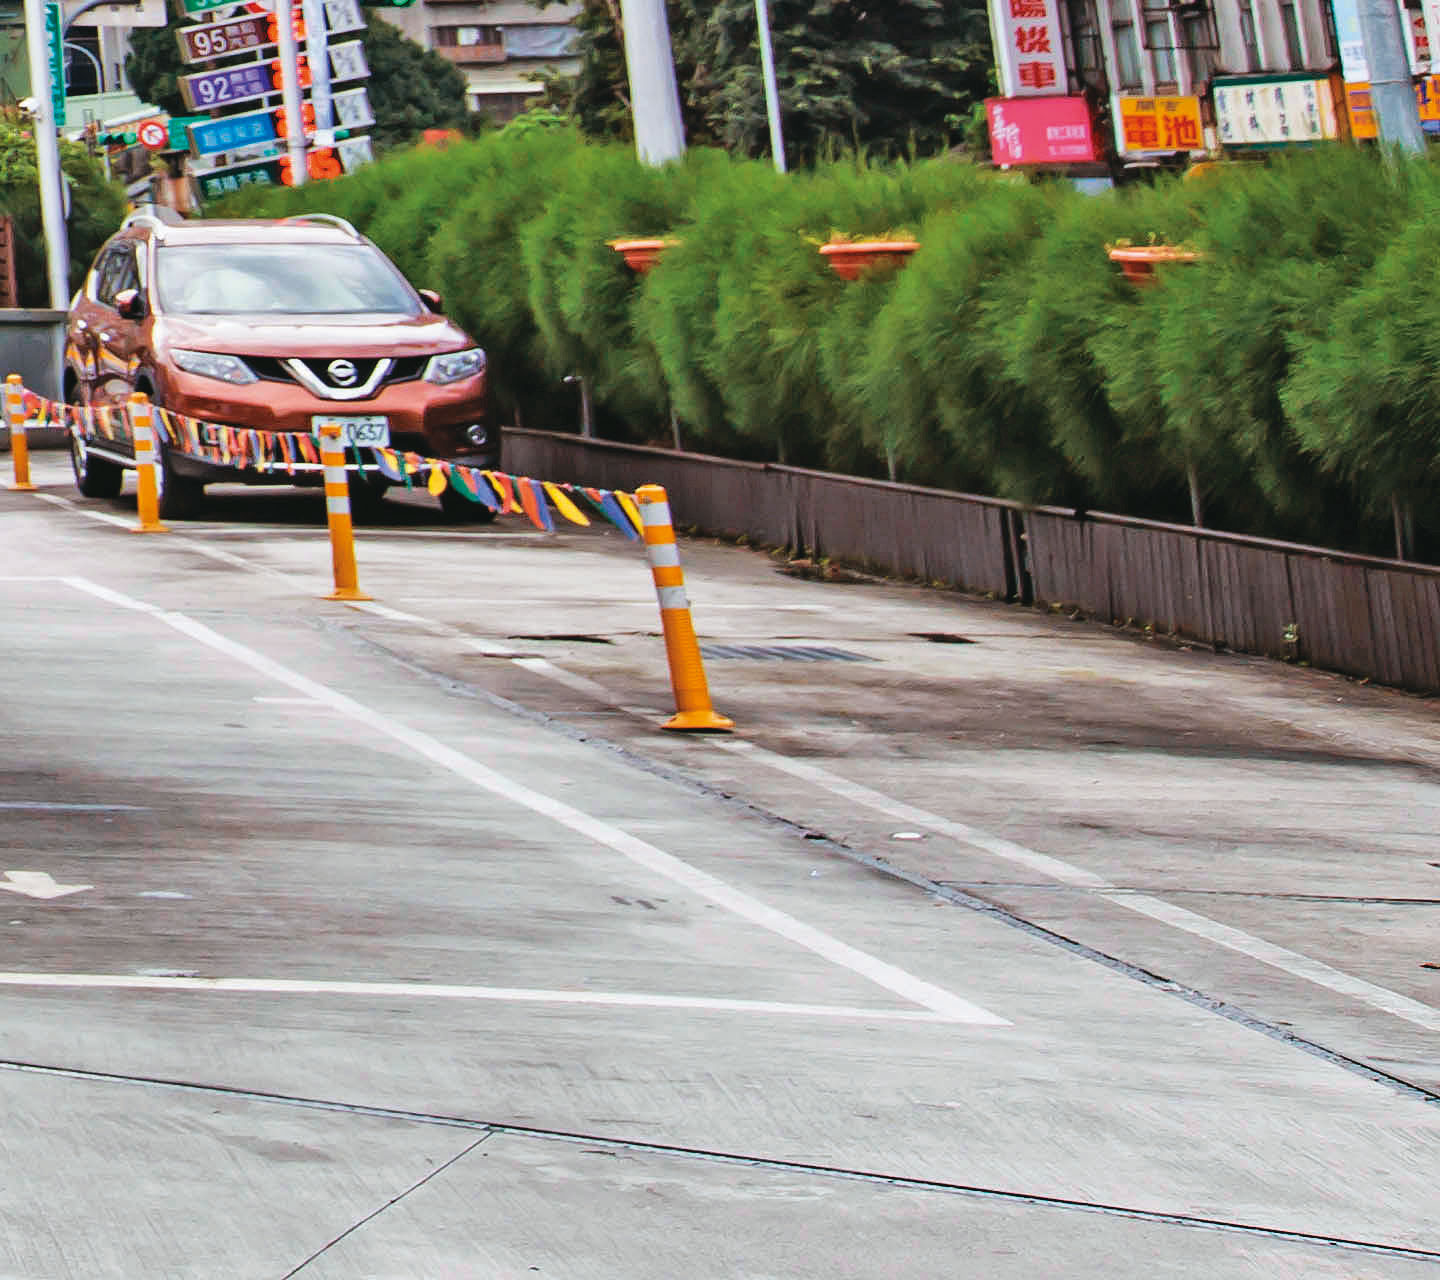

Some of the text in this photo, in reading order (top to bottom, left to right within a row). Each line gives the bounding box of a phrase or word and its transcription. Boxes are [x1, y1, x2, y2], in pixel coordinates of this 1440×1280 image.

[193, 28, 228, 56] 95
[197, 76, 233, 104] 92
[1122, 114, 1199, 149] 電池
